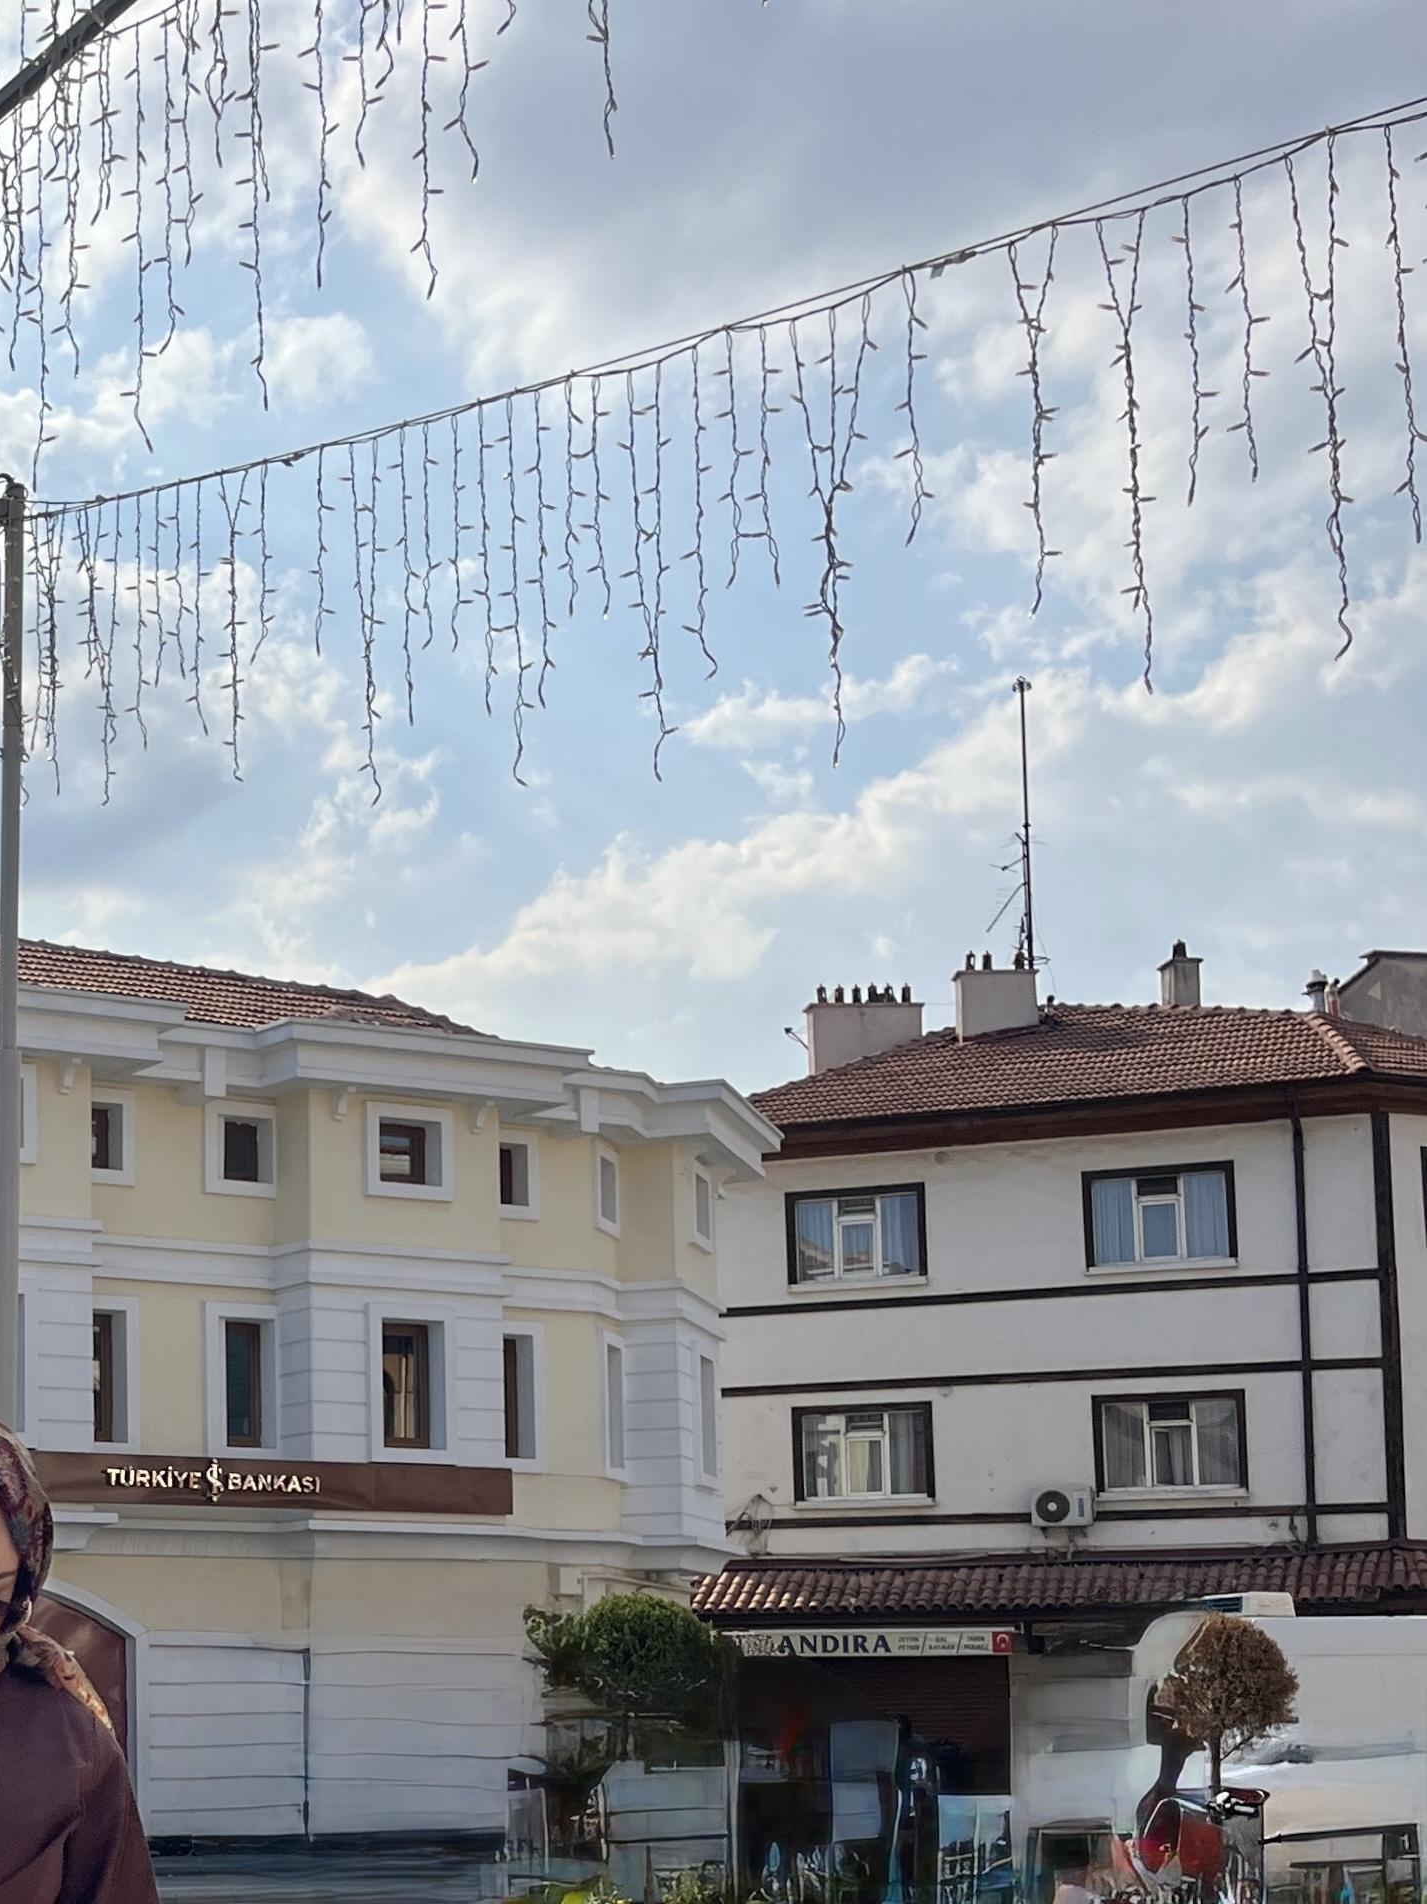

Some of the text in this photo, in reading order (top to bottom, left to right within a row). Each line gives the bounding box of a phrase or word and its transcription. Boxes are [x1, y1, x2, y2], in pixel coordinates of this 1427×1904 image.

[106, 1465, 202, 1489] TÜRKİYE
[228, 1472, 321, 1493] BANKASI
[778, 1635, 892, 1654] ANDIRA
